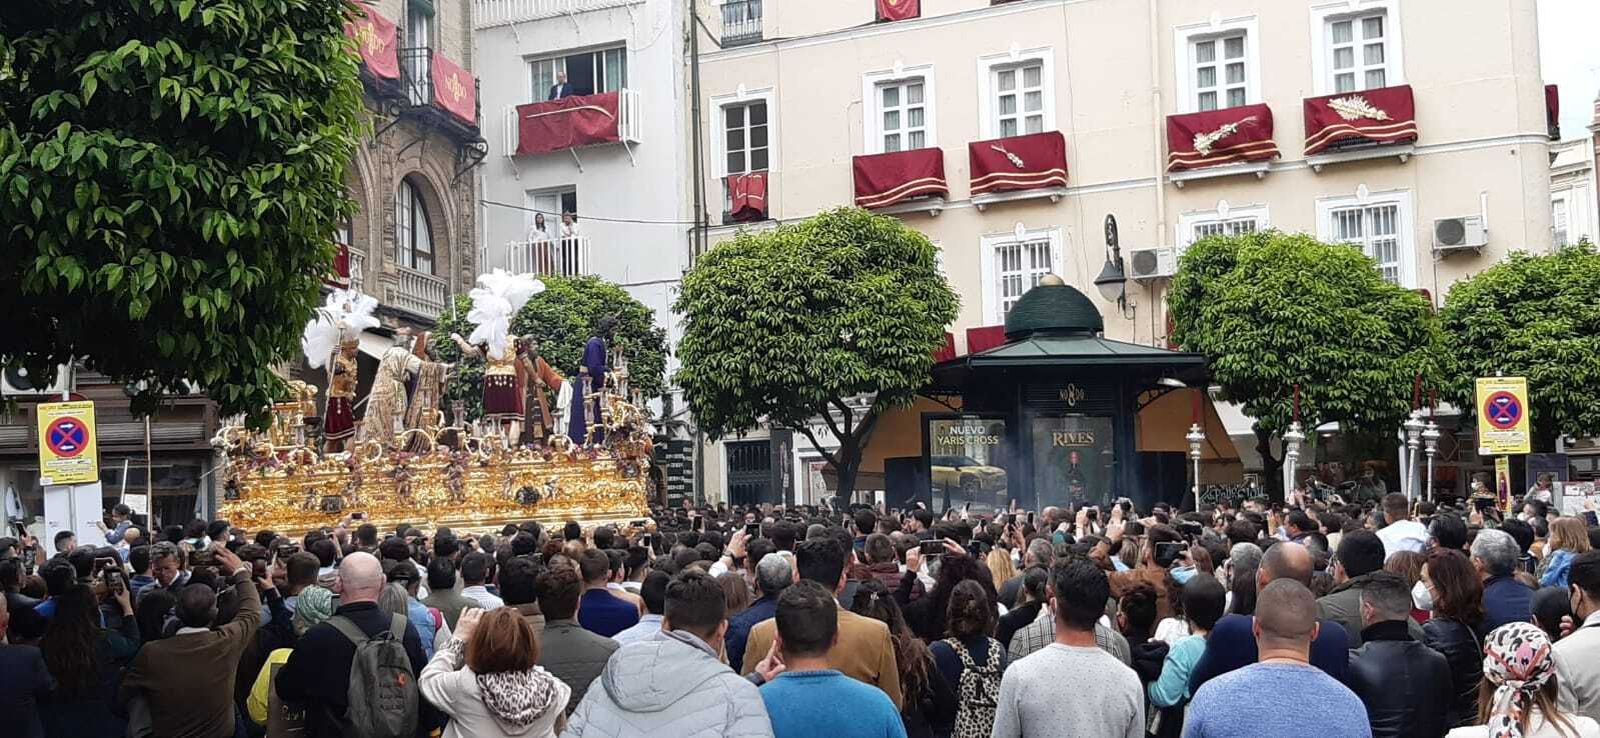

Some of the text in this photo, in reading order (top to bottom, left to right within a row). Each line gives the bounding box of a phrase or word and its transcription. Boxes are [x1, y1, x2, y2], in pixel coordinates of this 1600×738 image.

[949, 425, 985, 435] NUEVO
[938, 435, 999, 445] YARIS CROSS
[1053, 431, 1095, 448] RIVES
